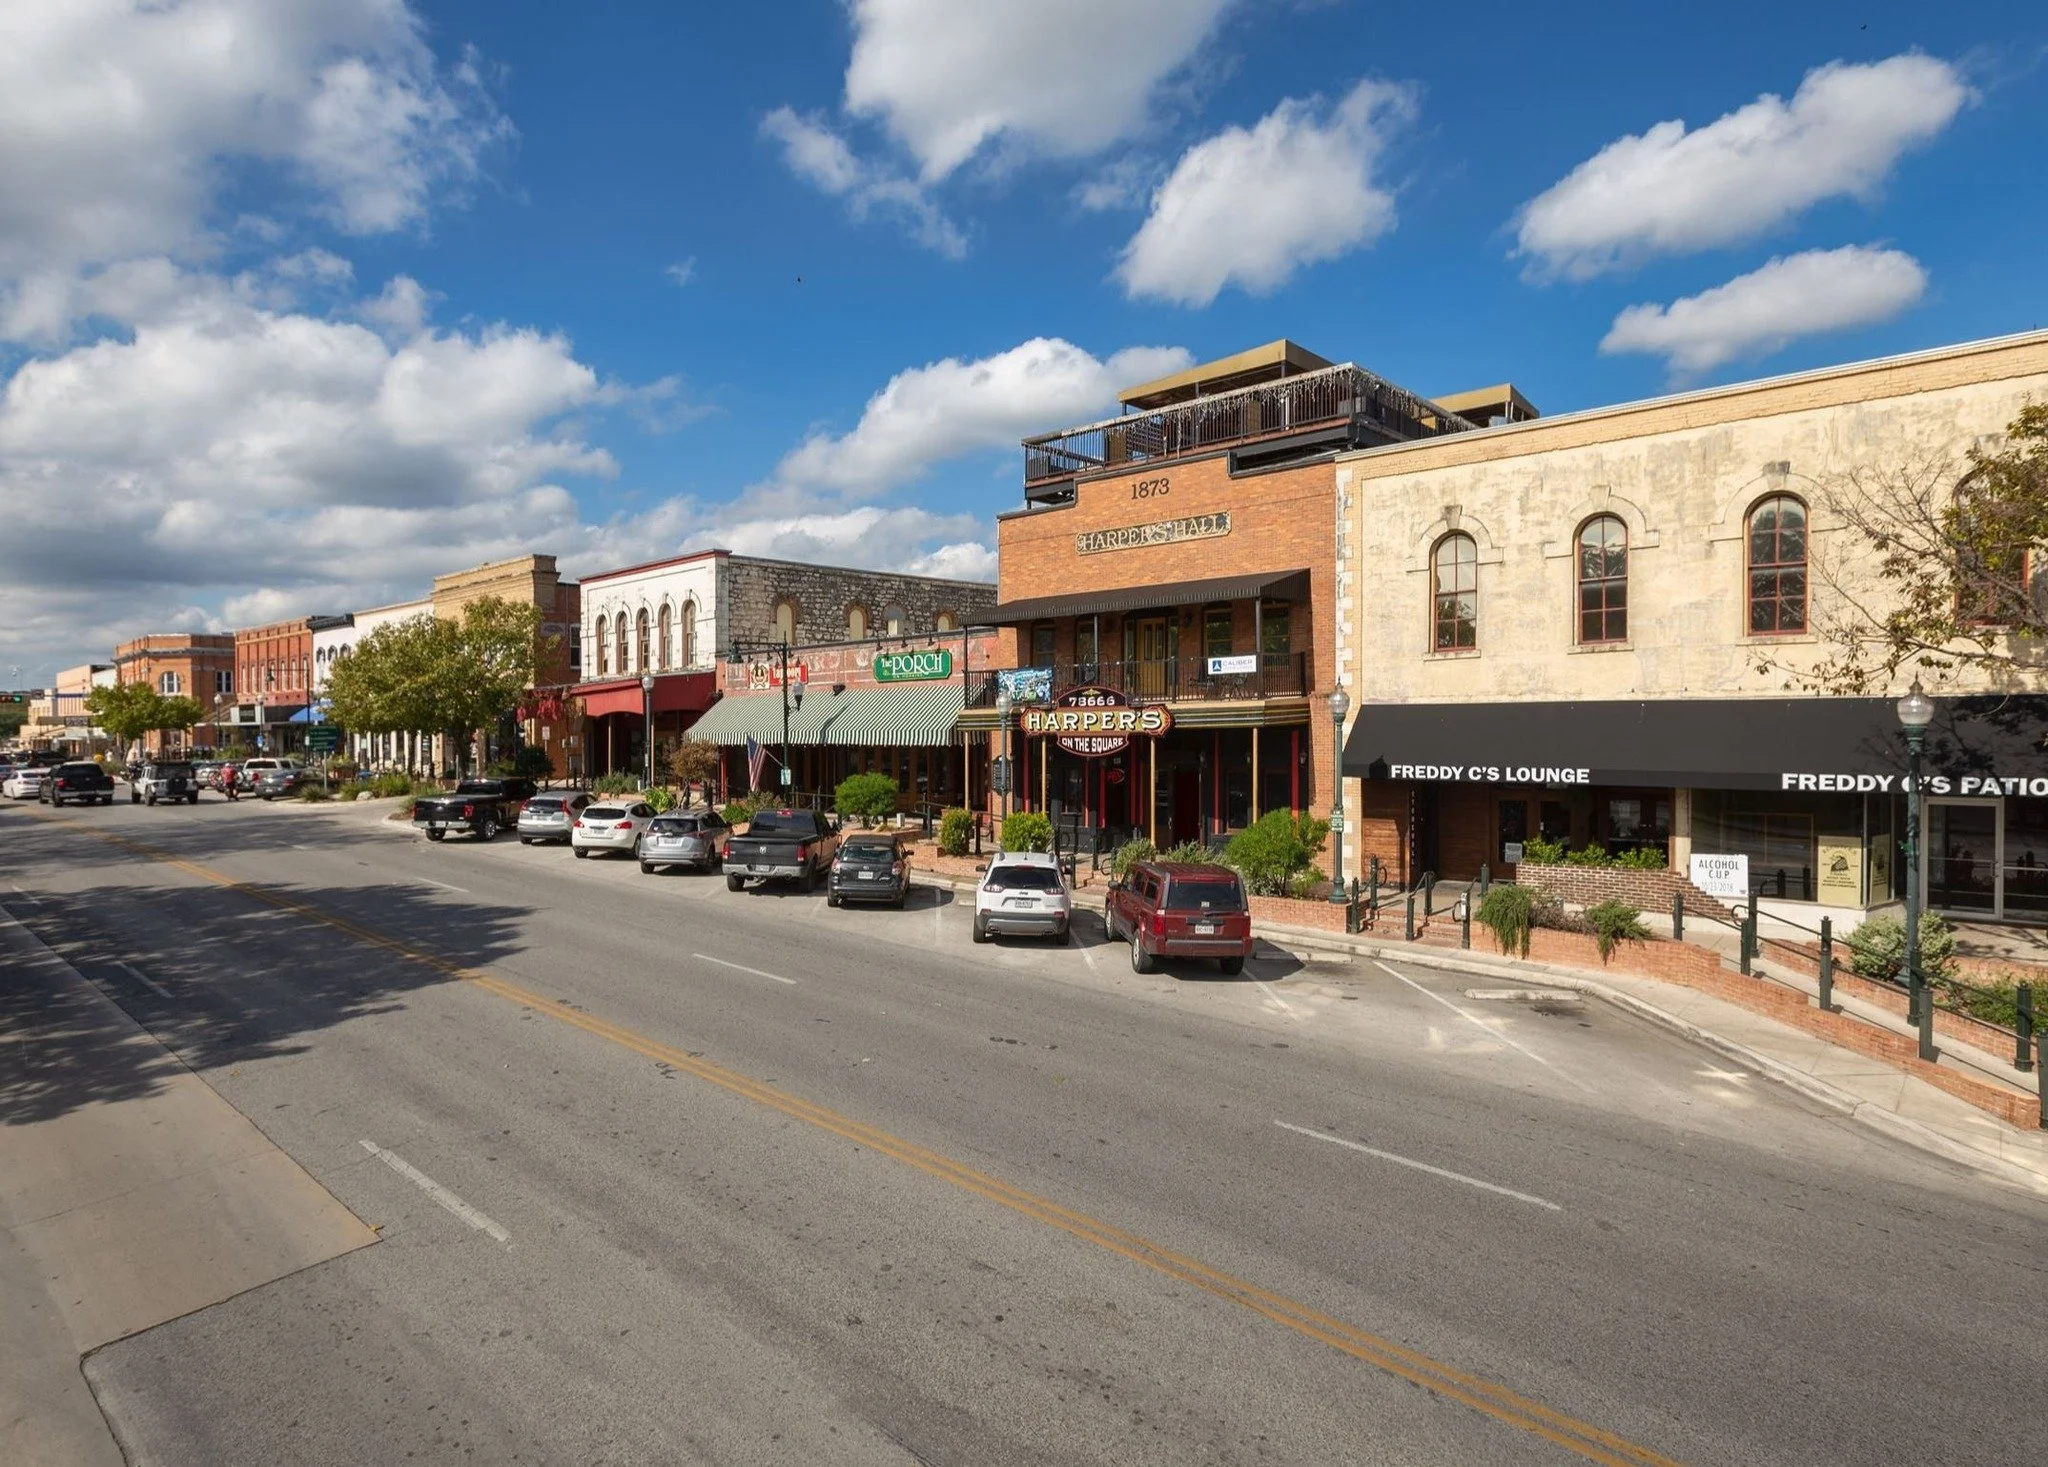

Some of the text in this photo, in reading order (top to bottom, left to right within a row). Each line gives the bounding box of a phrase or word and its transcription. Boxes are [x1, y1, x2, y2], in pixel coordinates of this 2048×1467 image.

[1131, 477, 1170, 500] 1873
[1174, 514, 1226, 539] HALL
[892, 653, 943, 676] PORCH
[1068, 696, 1115, 707] 78666
[1027, 710, 1162, 731] HARPER'S
[1061, 737, 1124, 753] ON THE SQUARE
[1390, 765, 1590, 784] FREDDY C'S LOUNGE
[1781, 773, 1895, 792] FREDDY
[1699, 859, 1740, 871] ALCOHOL
[1708, 870, 1730, 879] CUP
